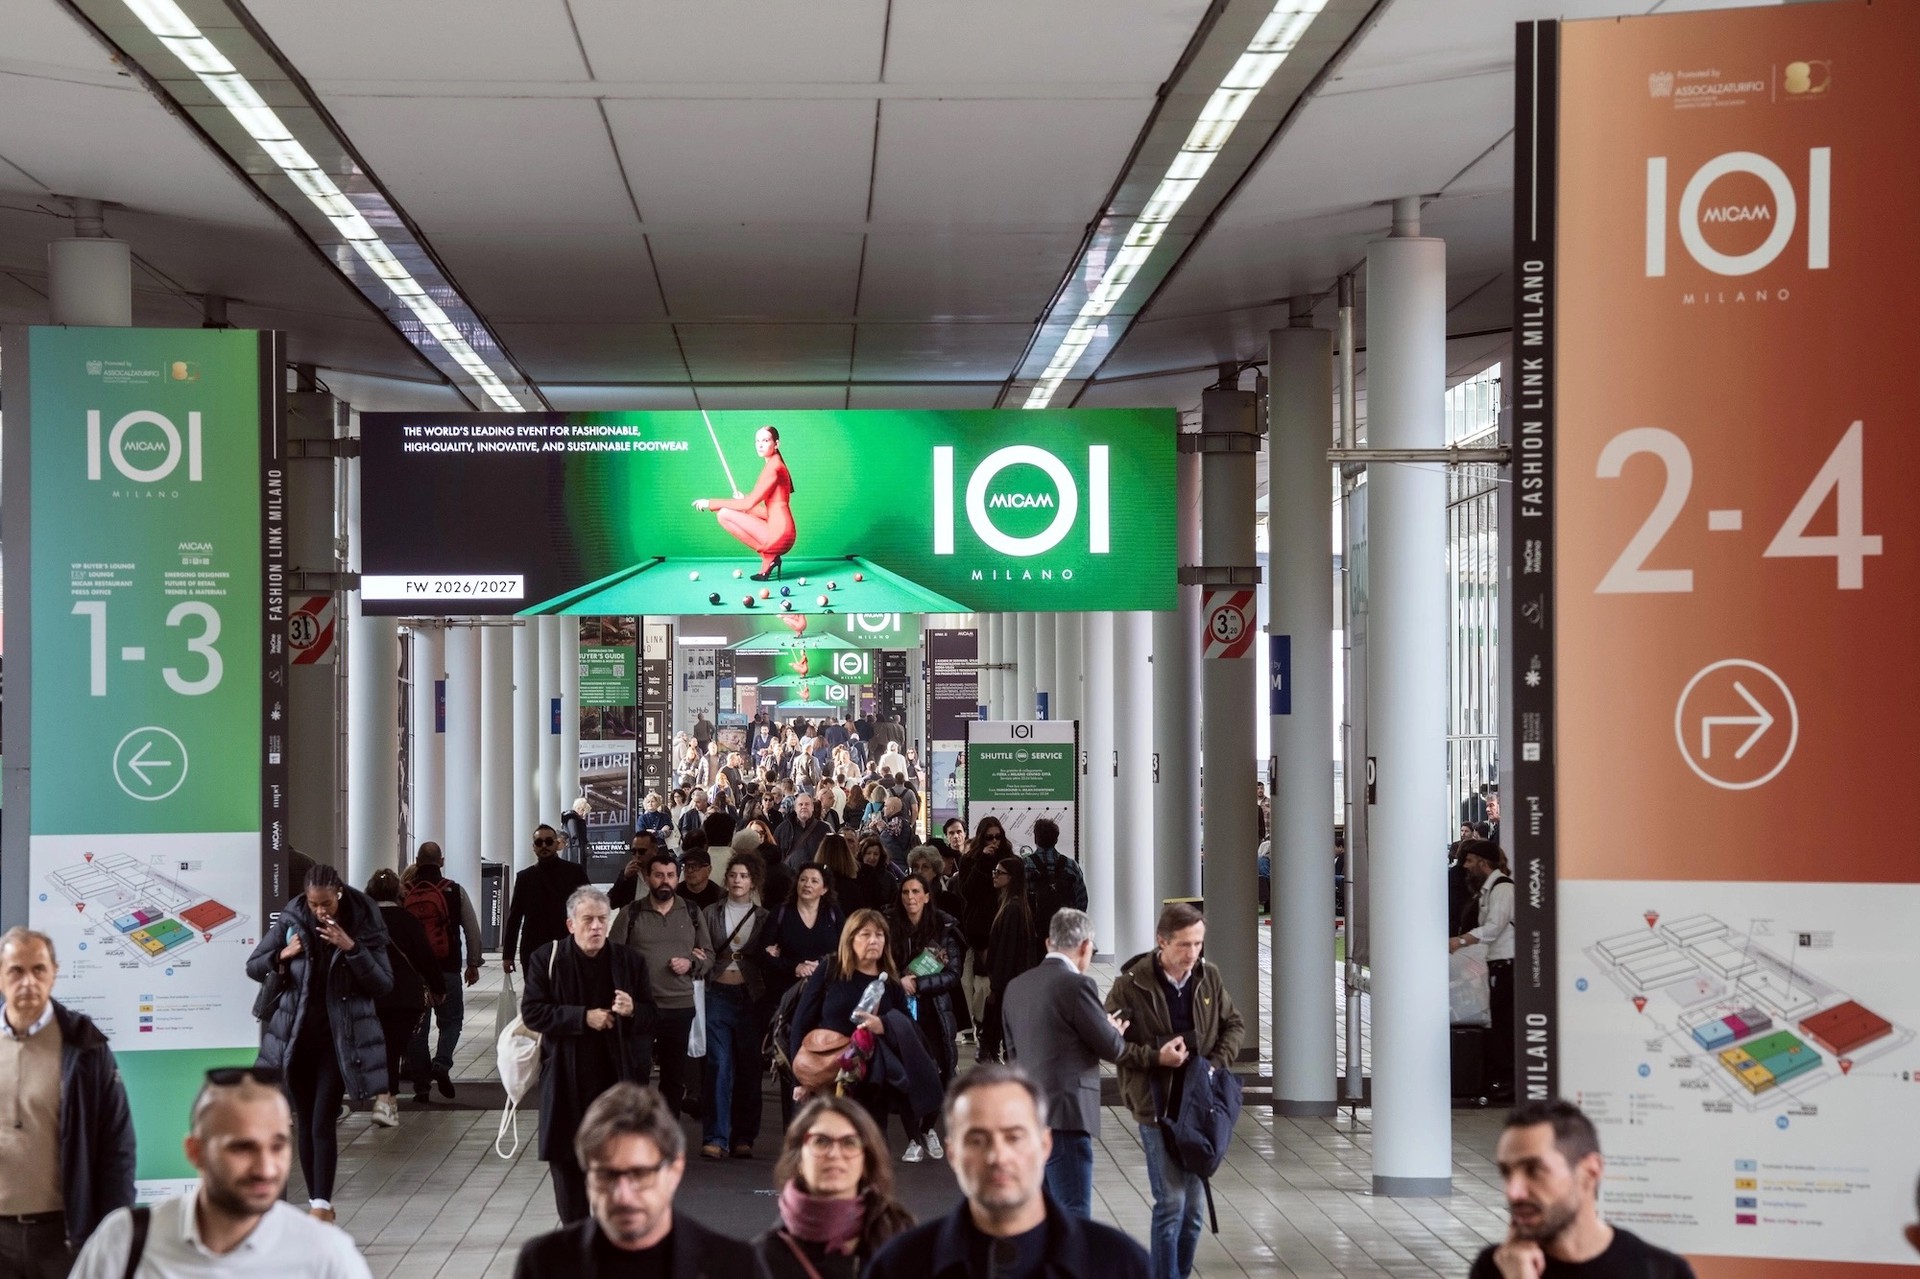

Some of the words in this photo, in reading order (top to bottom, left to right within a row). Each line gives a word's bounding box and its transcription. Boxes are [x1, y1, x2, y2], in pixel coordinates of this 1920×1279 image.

[1703, 205, 1770, 223] MICAM
[1523, 260, 1544, 346] MILANO
[1683, 289, 1790, 305] MILANO
[1523, 358, 1544, 409] LINK
[404, 426, 422, 436] THE
[424, 426, 469, 436] WORLD'S
[471, 426, 514, 436] LEADING
[517, 426, 548, 436] EVENT
[550, 426, 570, 436] FOR
[572, 426, 641, 437] FASHIONABLE,
[124, 441, 166, 451] MICAM
[404, 442, 474, 453] HIGH-QUALITY,
[477, 442, 540, 453] INNOVATIVE,
[542, 442, 565, 451] AND
[567, 442, 631, 451] SUSTAINABLE
[633, 442, 688, 451] FOOTWEAR
[1522, 422, 1543, 517] FASHION
[268, 470, 282, 520] MILANO
[989, 493, 1054, 508] MICAM
[178, 542, 213, 550] MICAM
[269, 527, 282, 558] LINK
[972, 569, 1073, 580] MILANO
[269, 564, 282, 621] FASHION
[406, 582, 428, 593] FW
[435, 581, 516, 595] 2026/2027
[1217, 614, 1228, 634] 3
[582, 752, 630, 772] UTURE
[588, 810, 630, 827] ETAIL
[1529, 858, 1541, 909] MICAM
[1532, 931, 1540, 988] LINEAPELLE
[1526, 1013, 1548, 1101] MILANO
